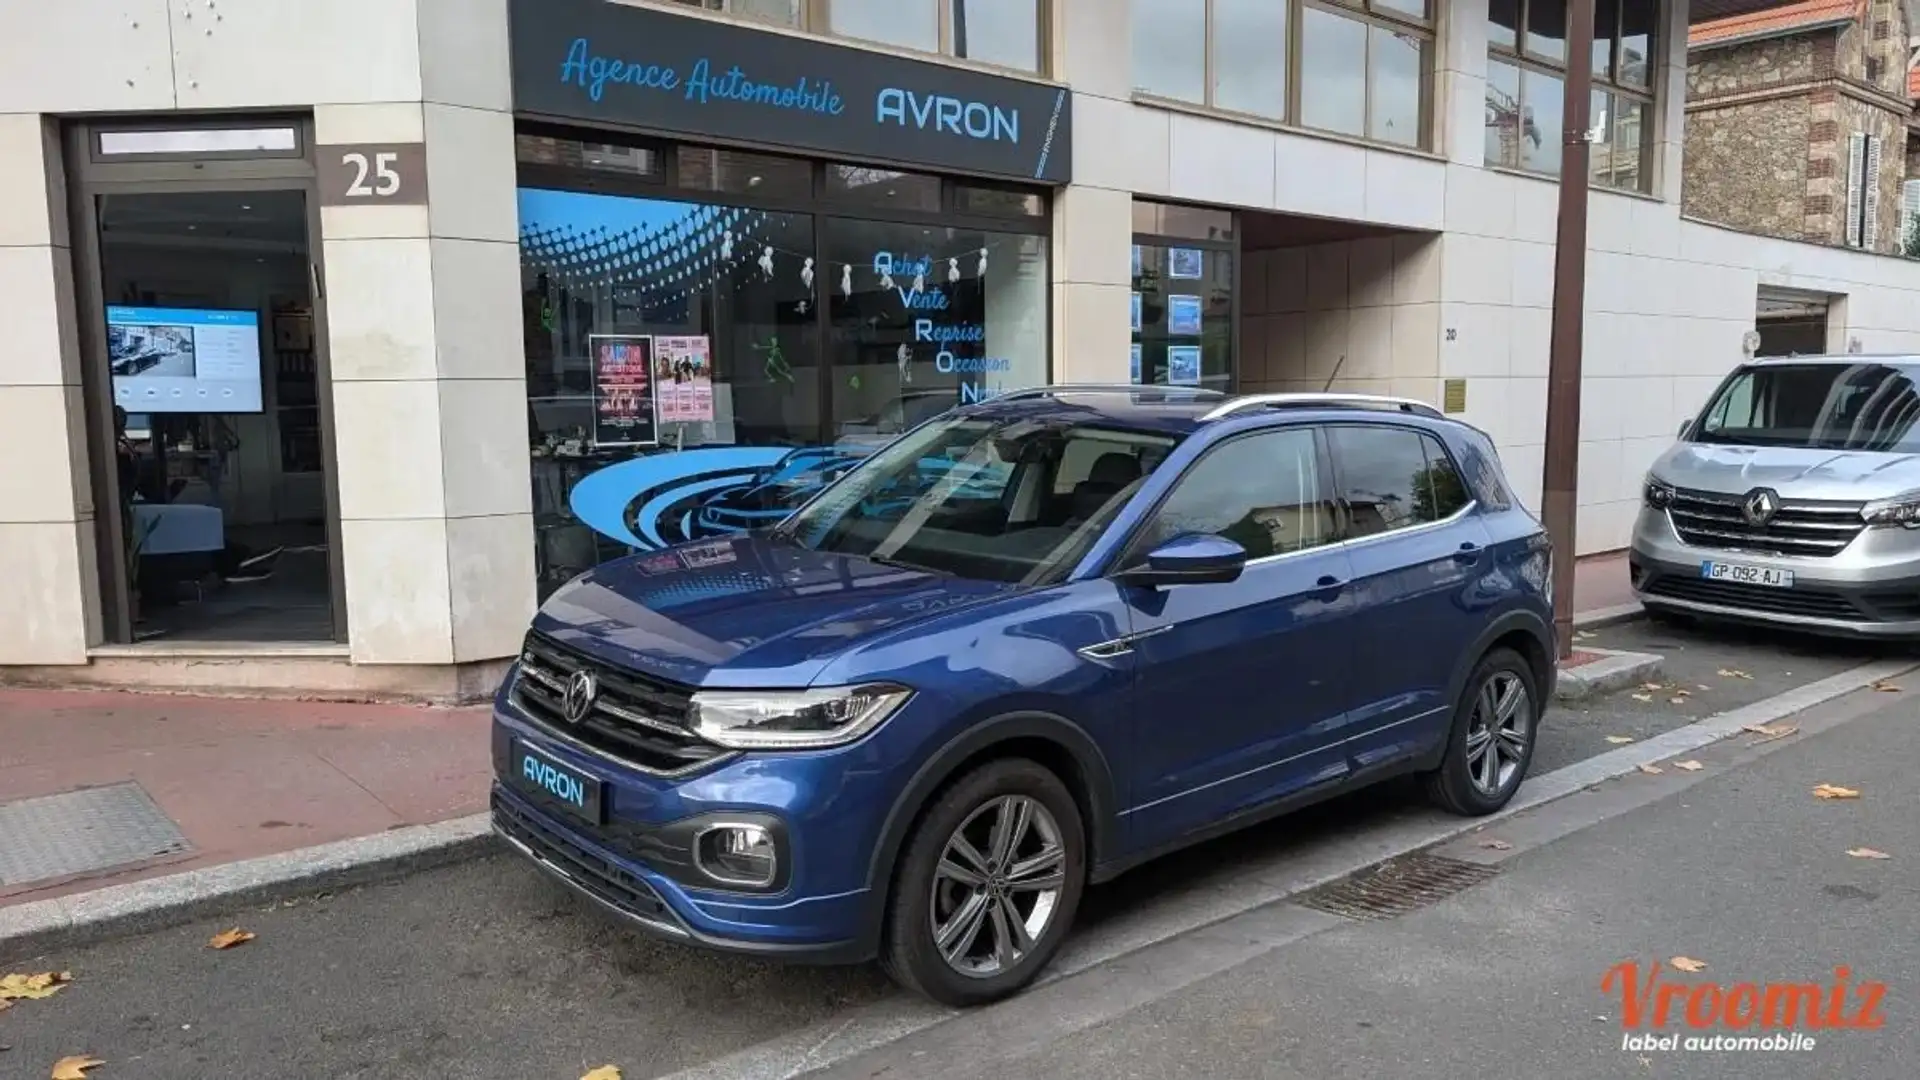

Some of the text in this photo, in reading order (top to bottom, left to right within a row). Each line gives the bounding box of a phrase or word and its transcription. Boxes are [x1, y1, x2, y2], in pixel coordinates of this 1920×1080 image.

[561, 38, 1019, 144] Agence Automobile AVRON
[342, 152, 401, 197] 25
[874, 251, 932, 276] Achat
[898, 285, 951, 311] Vente
[915, 319, 985, 353] Reprise
[936, 351, 1012, 374] Occasion
[523, 755, 584, 808] AVRON
